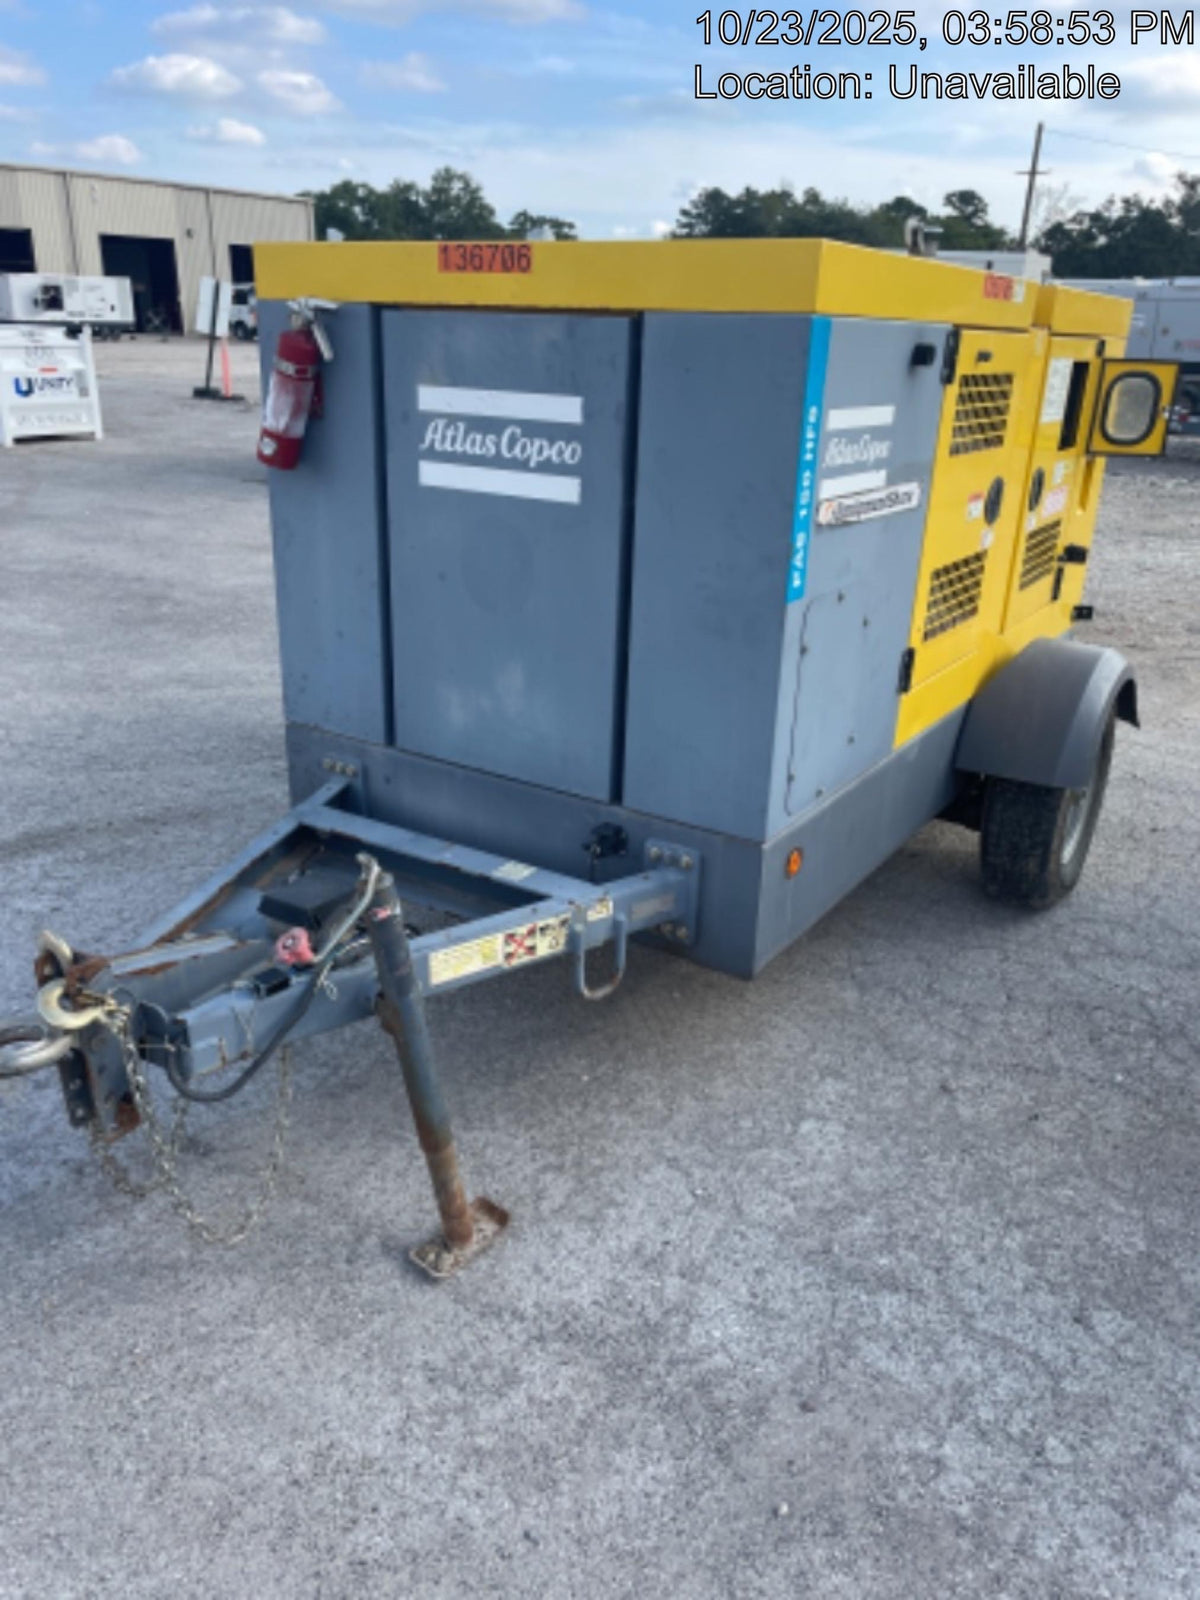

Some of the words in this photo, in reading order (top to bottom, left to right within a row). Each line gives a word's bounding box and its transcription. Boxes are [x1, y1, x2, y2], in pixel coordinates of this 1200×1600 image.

[440, 243, 532, 273] 136706
[418, 418, 498, 457] Atlas
[500, 424, 582, 468] Copco
